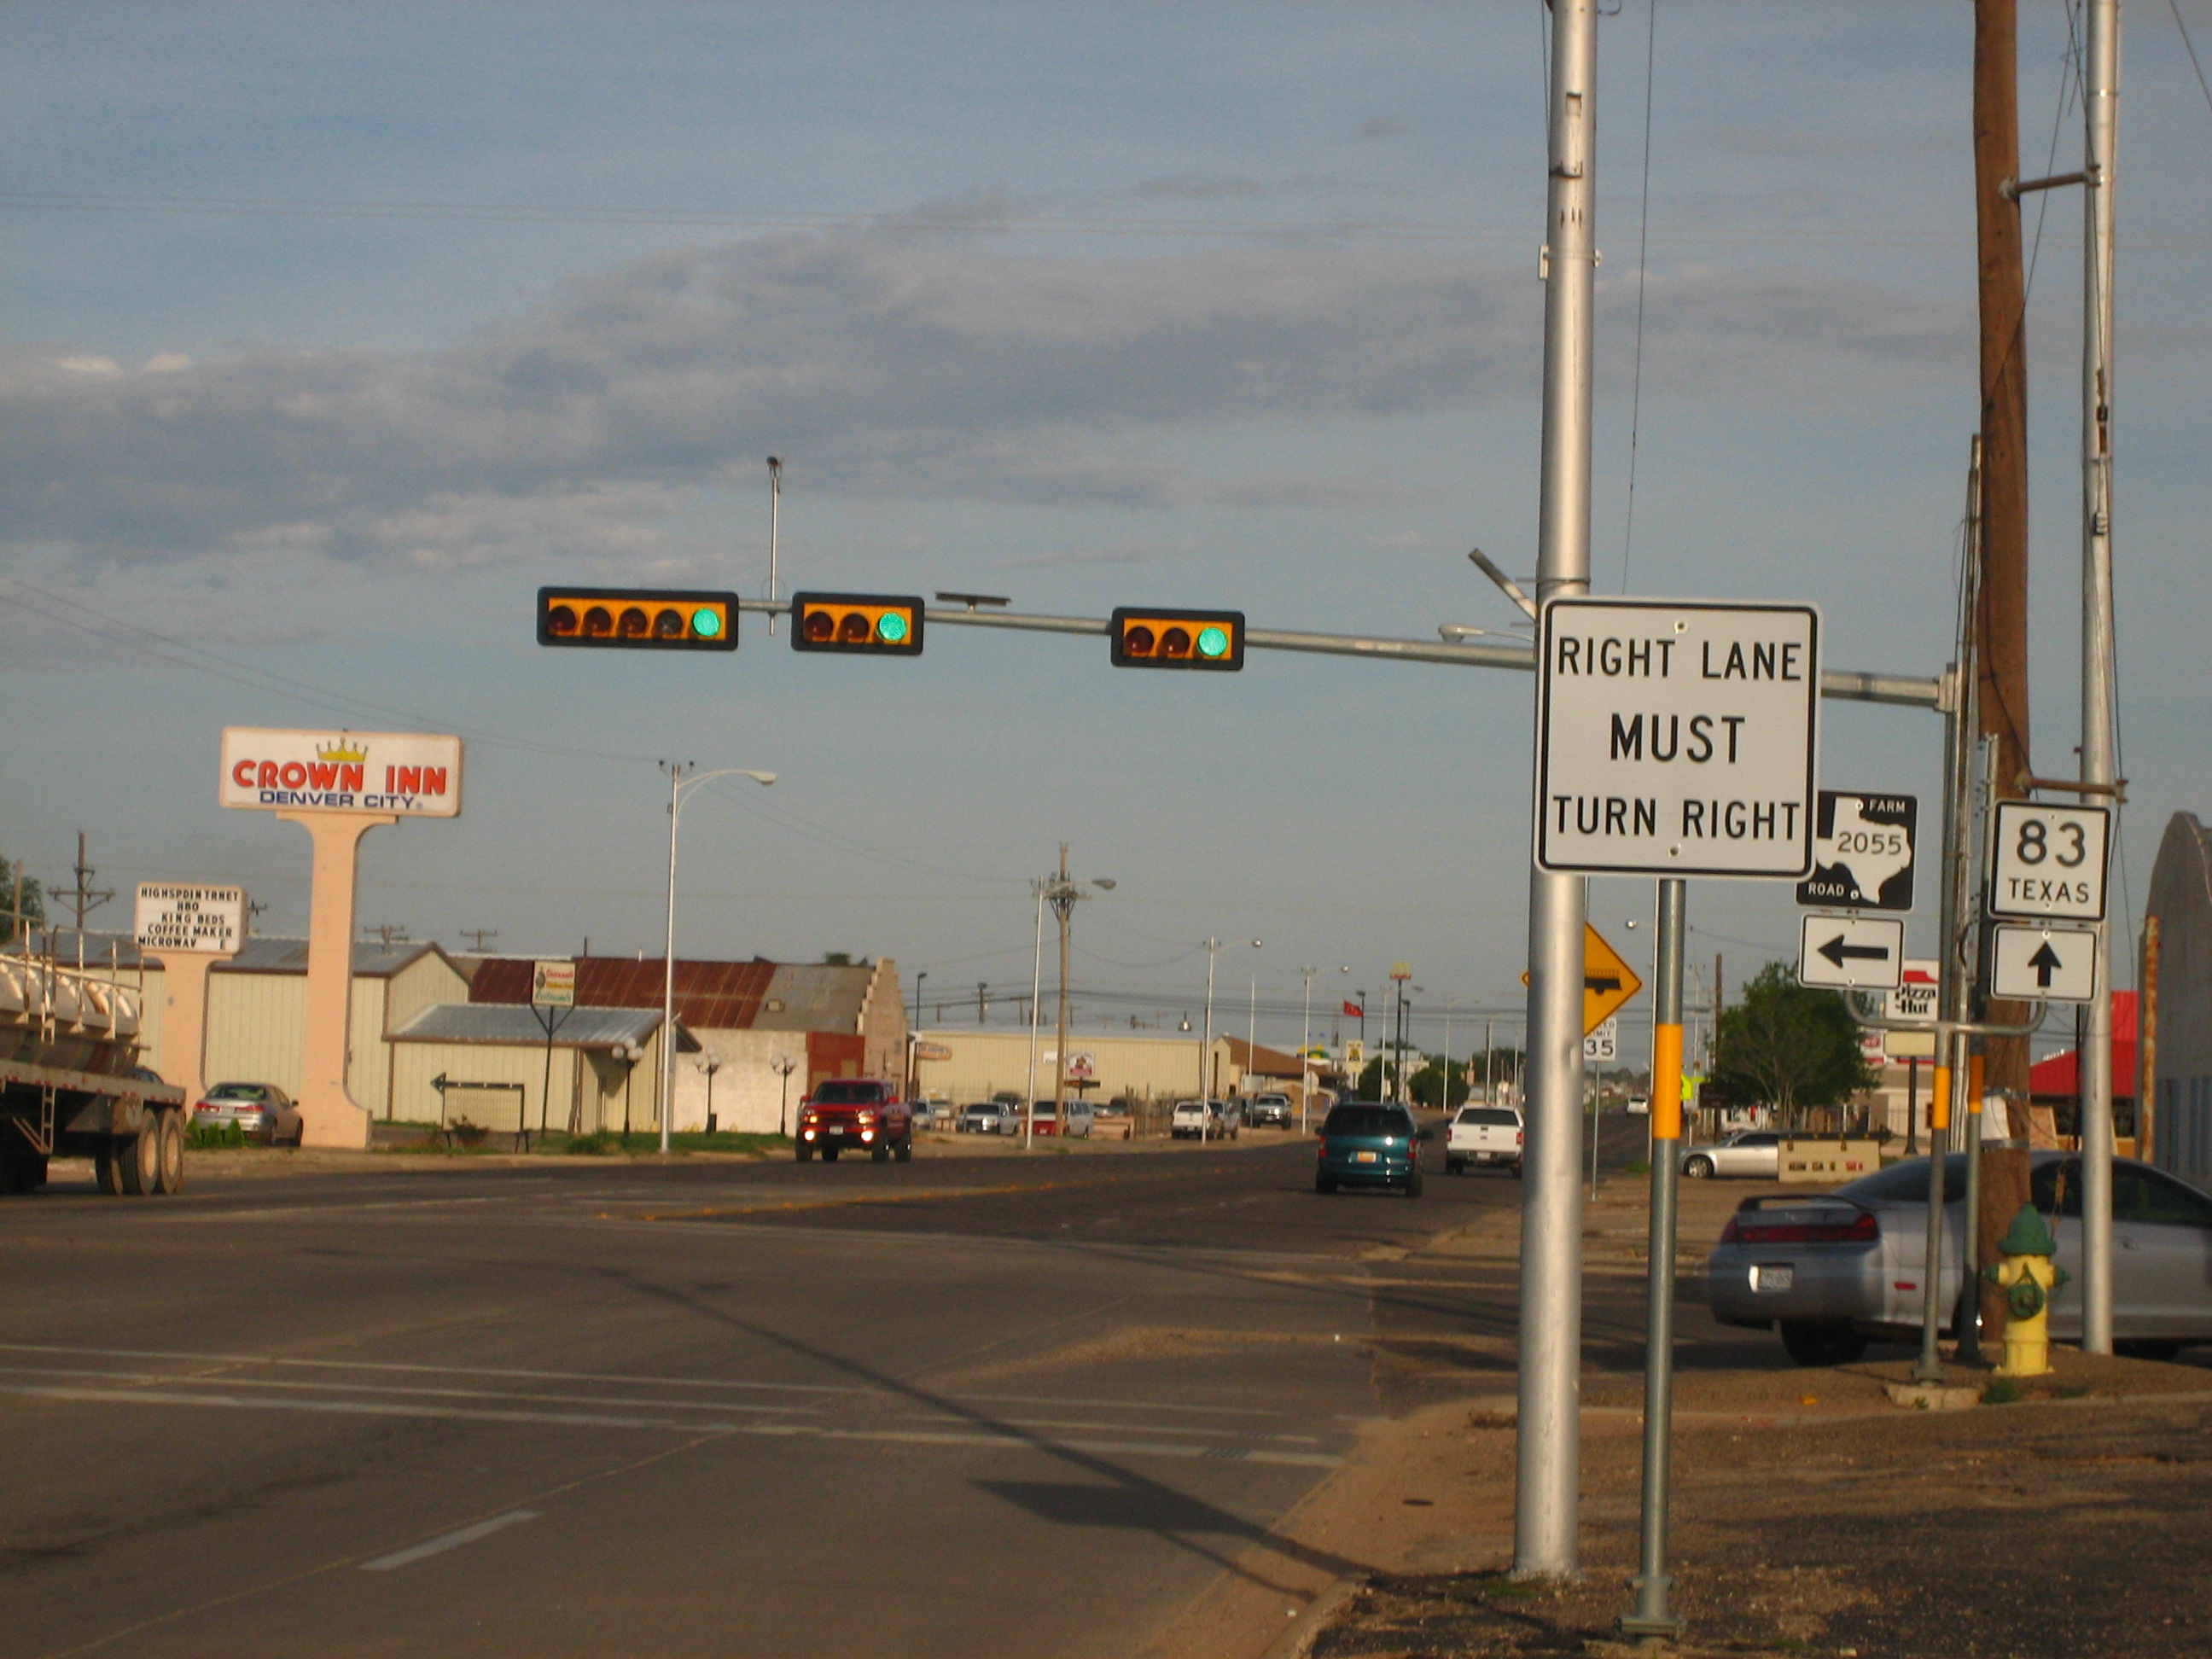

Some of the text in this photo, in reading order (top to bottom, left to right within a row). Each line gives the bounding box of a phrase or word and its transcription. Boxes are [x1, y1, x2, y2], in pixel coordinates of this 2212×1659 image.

[1557, 636, 1802, 681] RIGHT LANE
[1610, 712, 1745, 764] MUST
[232, 760, 446, 795] CROWN INN
[259, 789, 415, 809] DENVER CITY
[1869, 799, 1906, 813] FARM
[1552, 795, 1801, 841] TURN RIGHT
[1837, 831, 1901, 855] 2055
[2017, 819, 2085, 869] 83
[1808, 882, 1844, 897] ROAD
[2008, 877, 2089, 905] TEXAS
[177, 901, 199, 912] HBO
[161, 912, 224, 925] KING BEDS
[148, 923, 232, 938] COFFEE MAKER
[1895, 999, 1928, 1014] Hut
[1585, 1039, 1614, 1057] 35
